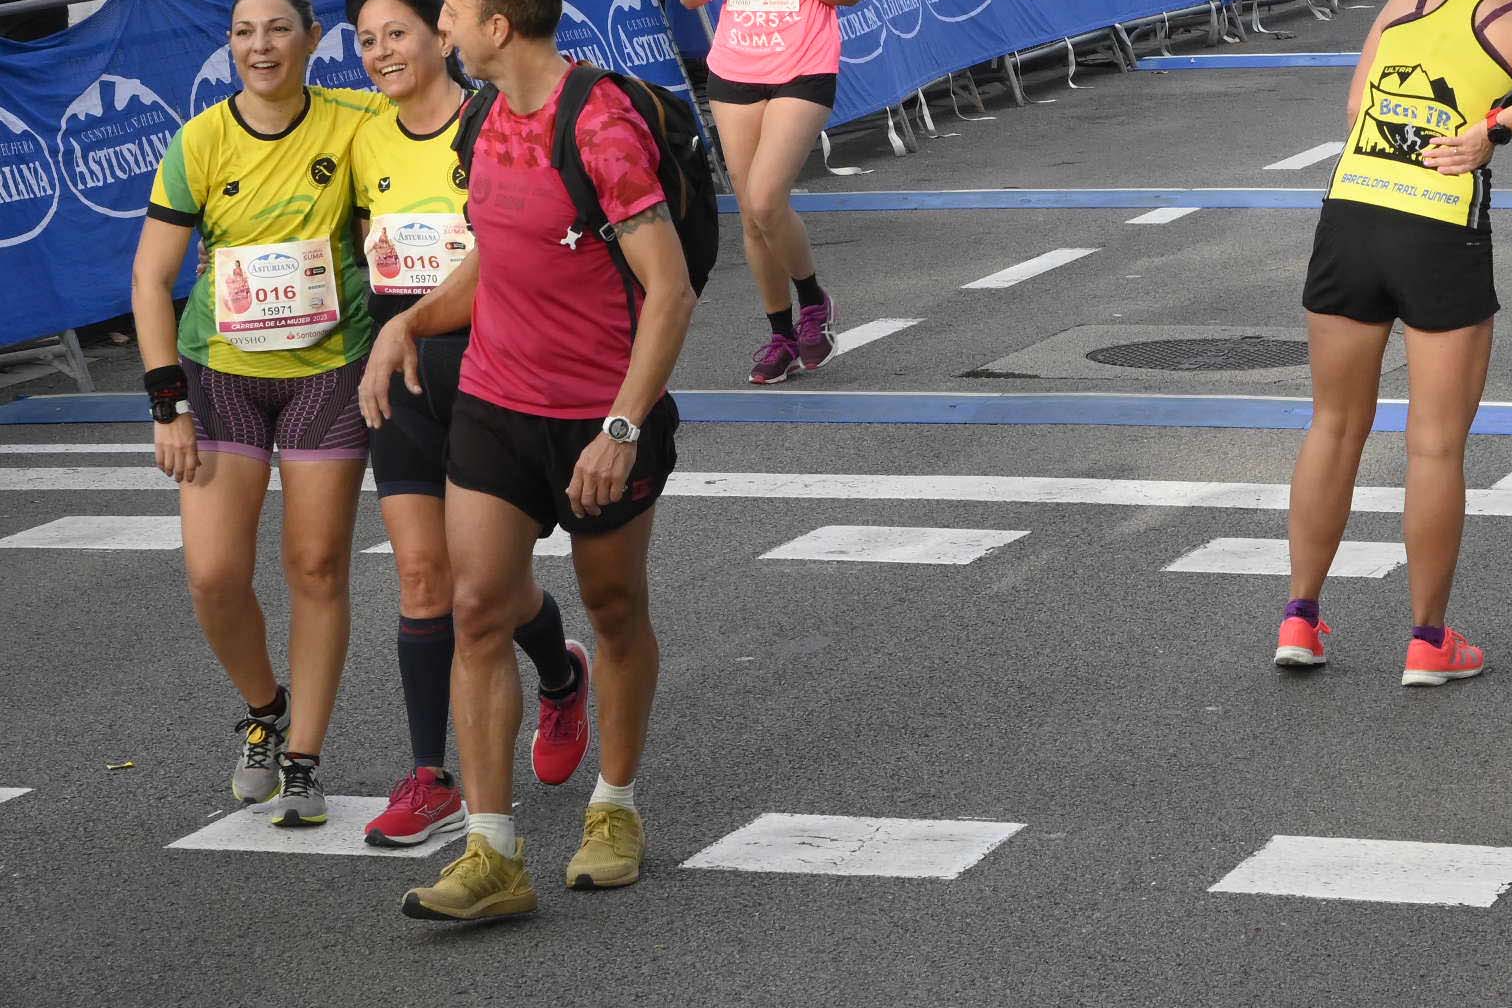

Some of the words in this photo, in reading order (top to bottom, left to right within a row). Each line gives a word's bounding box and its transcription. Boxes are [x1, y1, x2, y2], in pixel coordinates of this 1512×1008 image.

[627, 16, 660, 31] CENTRAL
[562, 27, 592, 42] LECHERA
[730, 28, 785, 47] SUMA
[617, 25, 679, 67] ASTUR
[326, 69, 363, 85] CENTRAL
[1380, 98, 1418, 120] Bcn
[1426, 105, 1453, 132] TR
[1341, 173, 1391, 190] BARCELONA
[1391, 182, 1419, 198] TRAIL
[1421, 189, 1460, 206] RUNNER
[251, 263, 297, 273] ASTURIANA
[403, 255, 440, 269] 016
[410, 274, 438, 284] 15970
[255, 285, 297, 303] 016
[261, 305, 293, 317] 15971
[231, 321, 264, 331] CARRERA
[265, 320, 275, 328] DE
[276, 319, 286, 327] LA
[286, 316, 311, 326] MUJER
[312, 313, 328, 322] 2023
[230, 335, 267, 345] OYSHO
